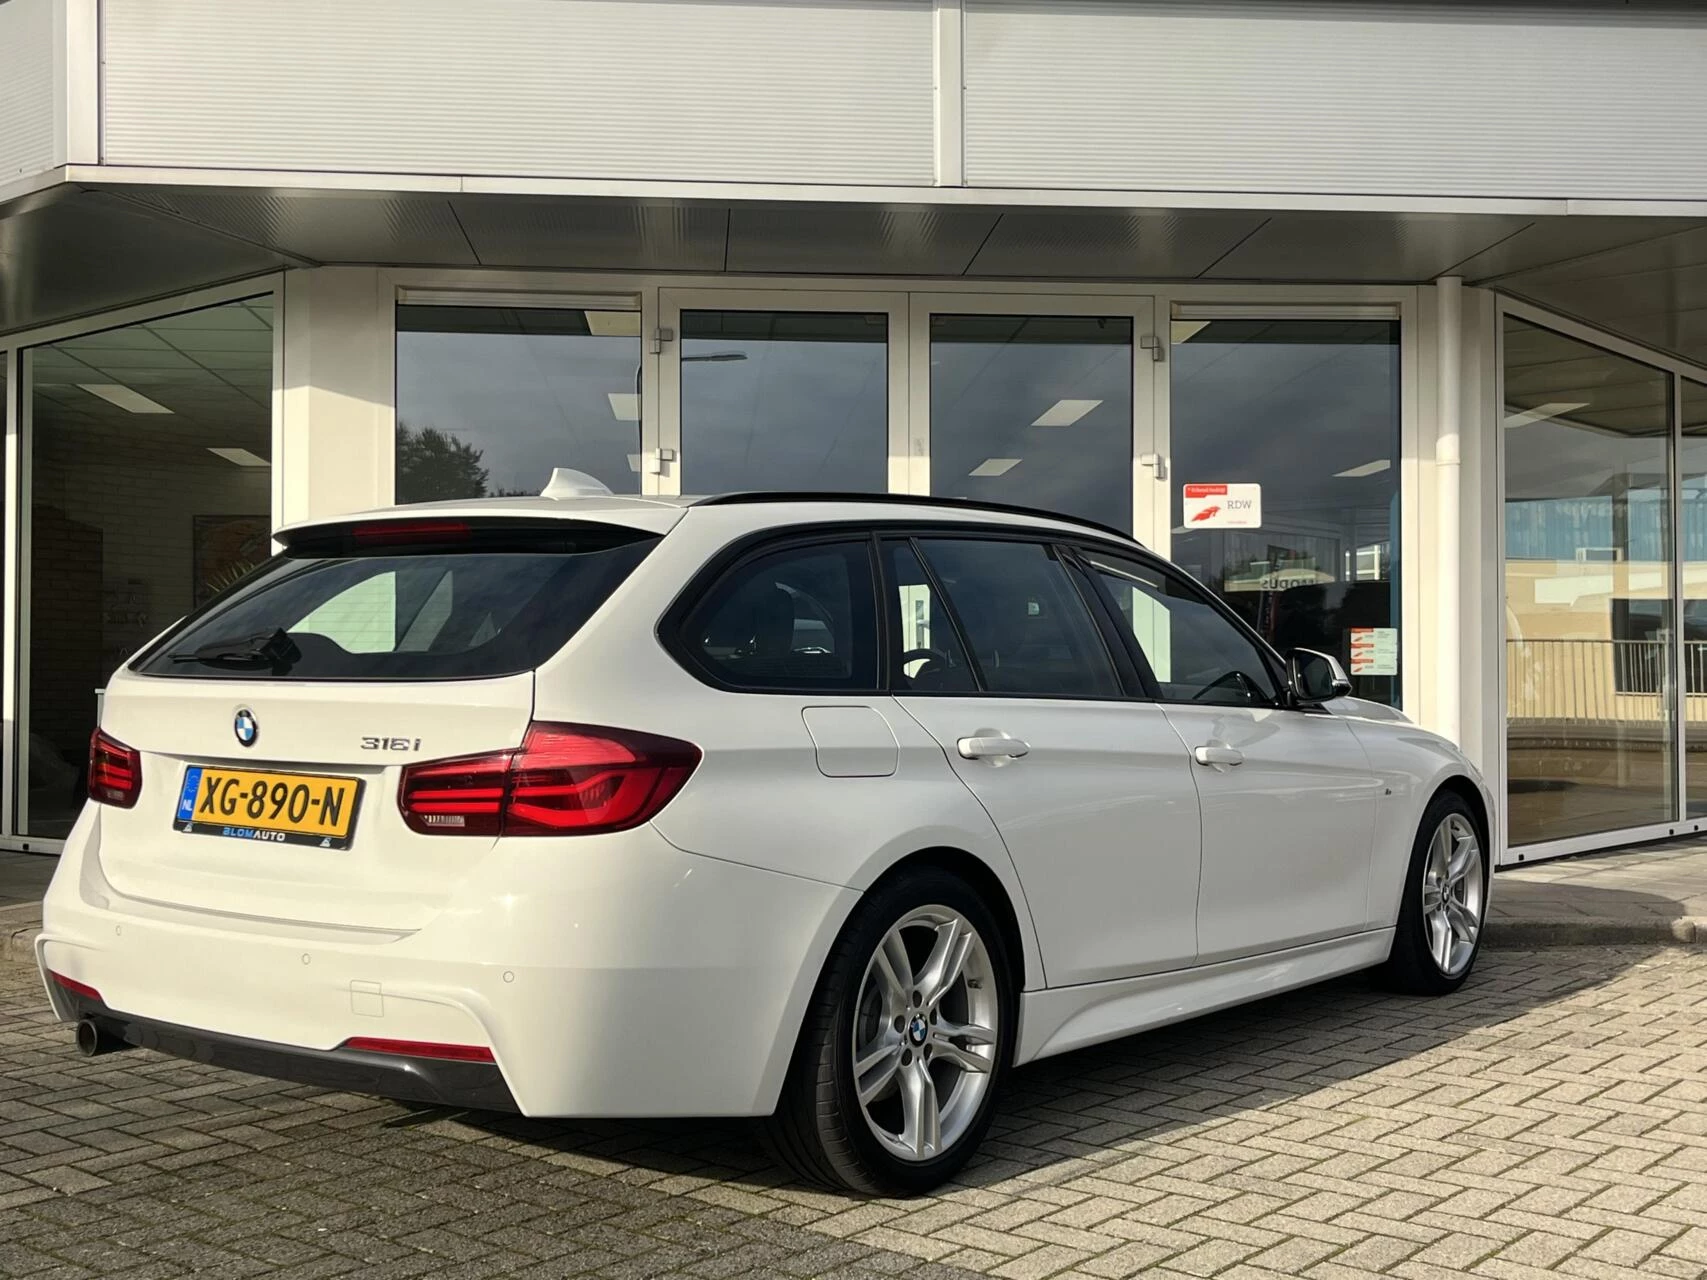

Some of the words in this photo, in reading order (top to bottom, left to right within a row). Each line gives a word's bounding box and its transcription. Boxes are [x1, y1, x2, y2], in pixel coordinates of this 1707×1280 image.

[1227, 500, 1252, 510] RDW
[181, 799, 193, 811] NL
[199, 776, 345, 827] XG-890-N
